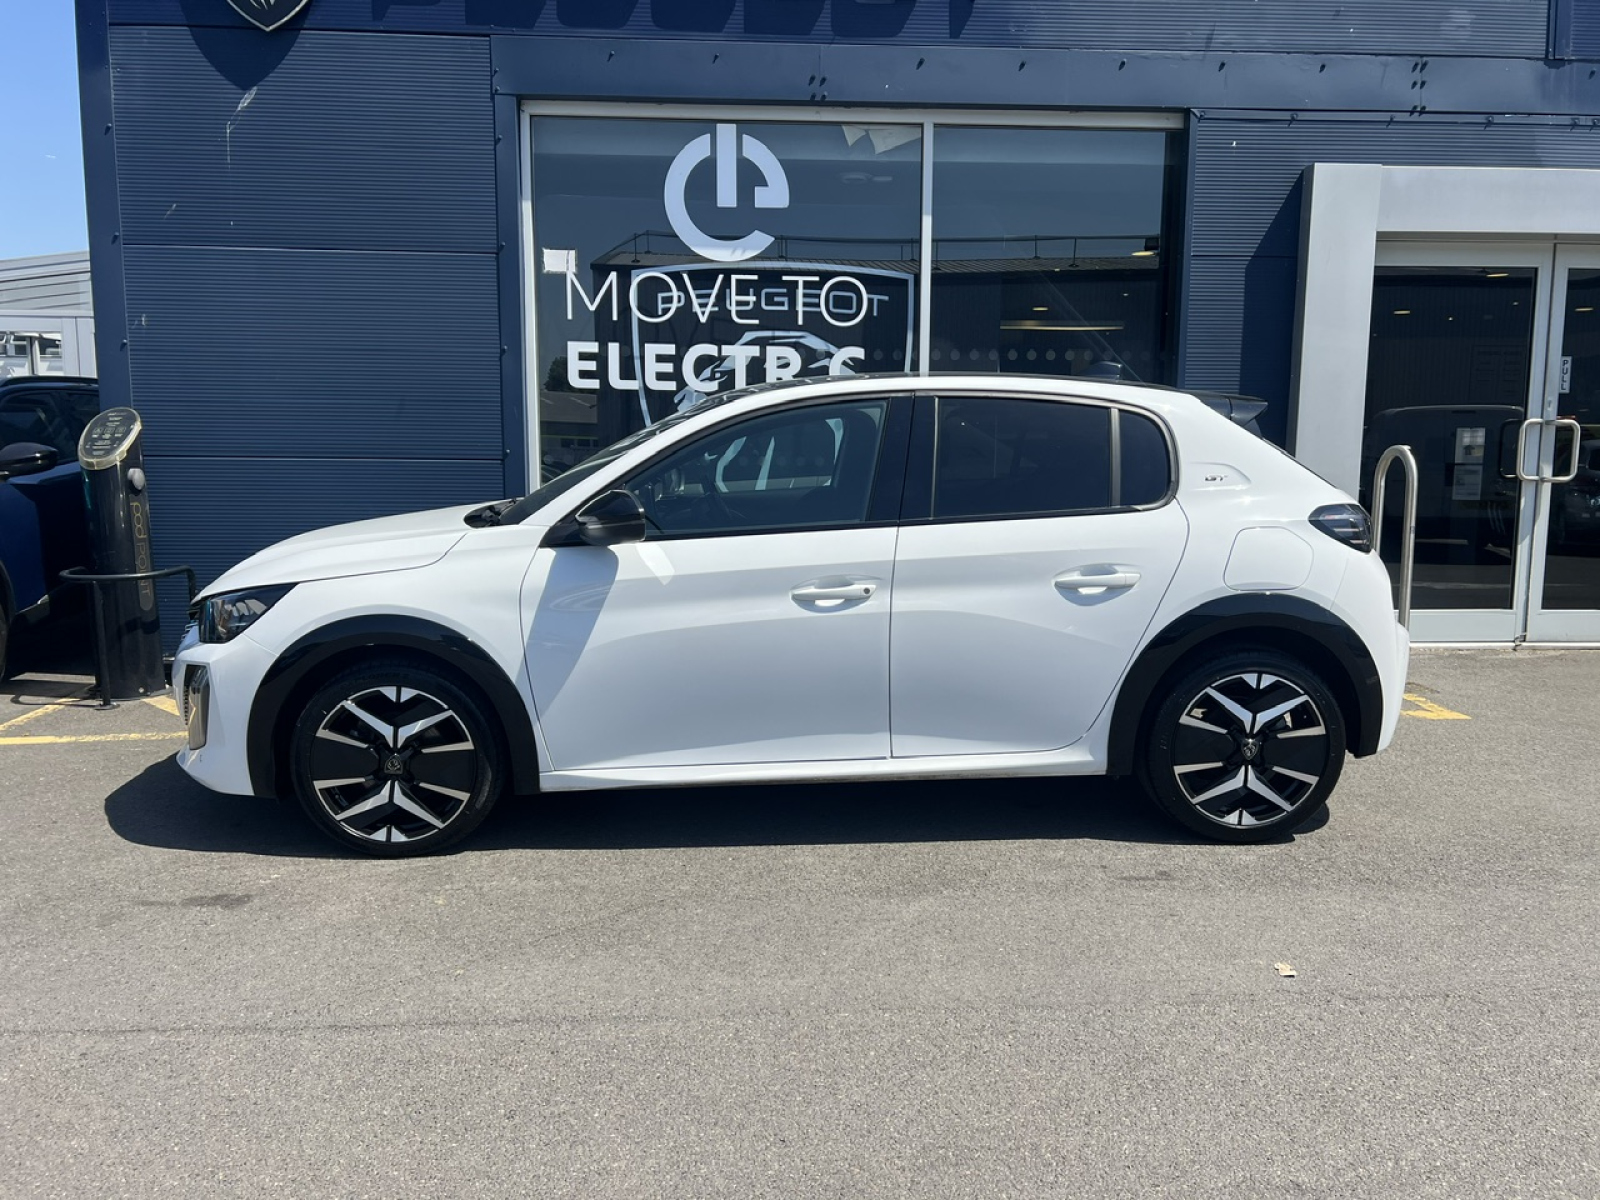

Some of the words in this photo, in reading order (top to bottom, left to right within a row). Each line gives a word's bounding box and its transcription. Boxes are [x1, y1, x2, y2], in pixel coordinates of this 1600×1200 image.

[565, 270, 760, 325] MOVE
[782, 275, 869, 327] TO
[657, 287, 890, 317] PEUGEOT
[1560, 359, 1569, 391] PULL
[129, 501, 147, 540] pod
